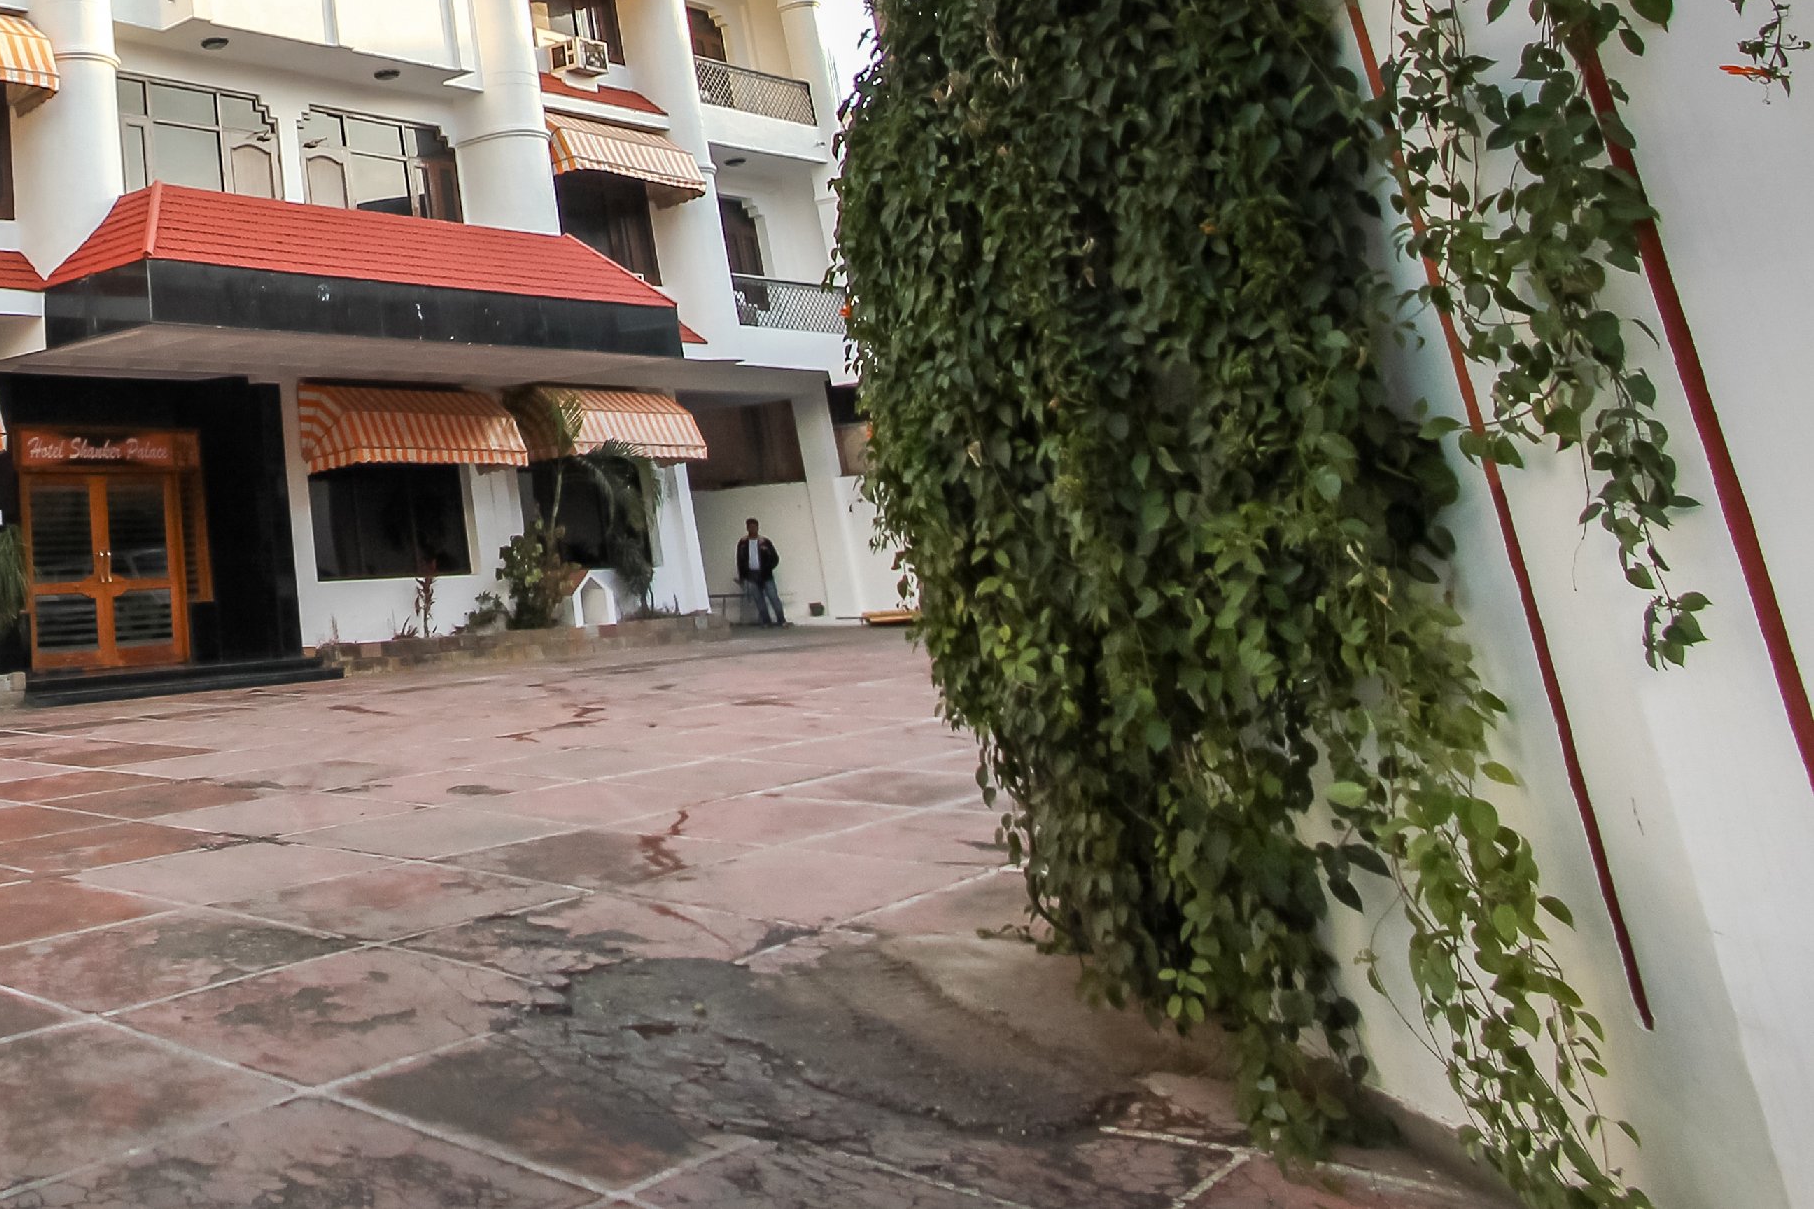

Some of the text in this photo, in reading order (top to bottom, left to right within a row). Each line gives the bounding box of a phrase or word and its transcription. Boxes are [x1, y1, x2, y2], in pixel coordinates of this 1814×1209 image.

[27, 436, 169, 460] Hotel Shanker Palace
